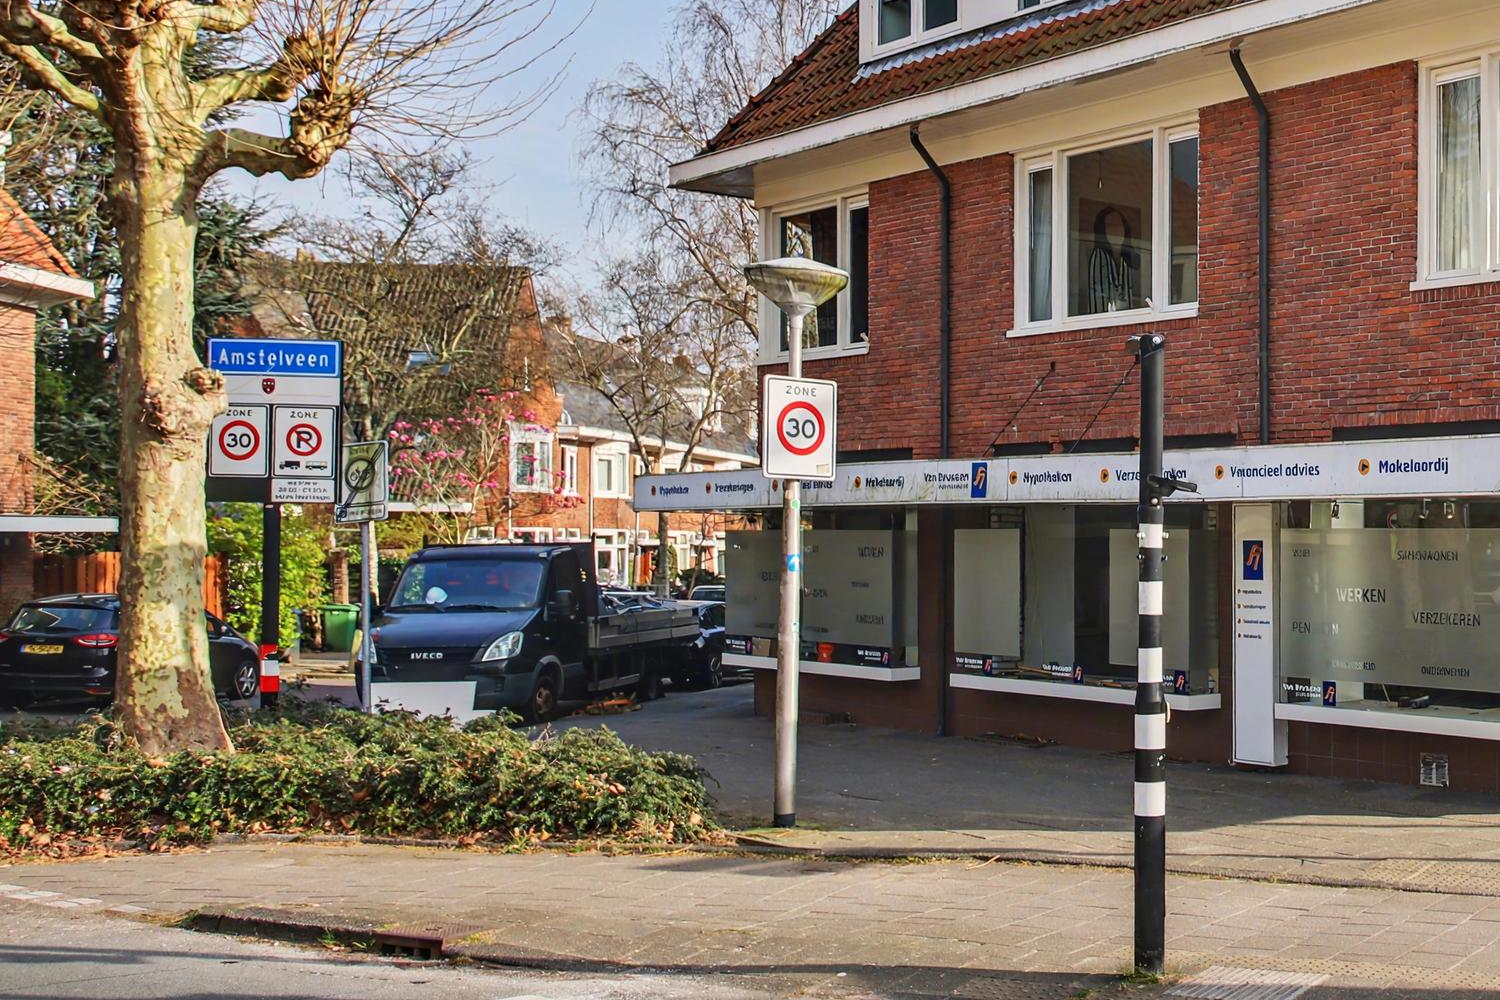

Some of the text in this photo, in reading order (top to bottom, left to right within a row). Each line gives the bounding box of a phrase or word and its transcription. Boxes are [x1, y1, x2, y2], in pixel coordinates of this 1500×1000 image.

[218, 348, 329, 368] Amstelveen
[785, 385, 817, 398] ZONE
[226, 409, 253, 417] ZONE
[289, 411, 319, 419] ZONE
[785, 418, 816, 439] 30
[226, 433, 252, 448] 30
[1285, 462, 1320, 477] advies
[1378, 457, 1449, 475] Makelaardij
[1336, 587, 1386, 603] WERKEN
[1412, 611, 1481, 627] VERZEKEREN
[410, 652, 444, 660] IVECO
